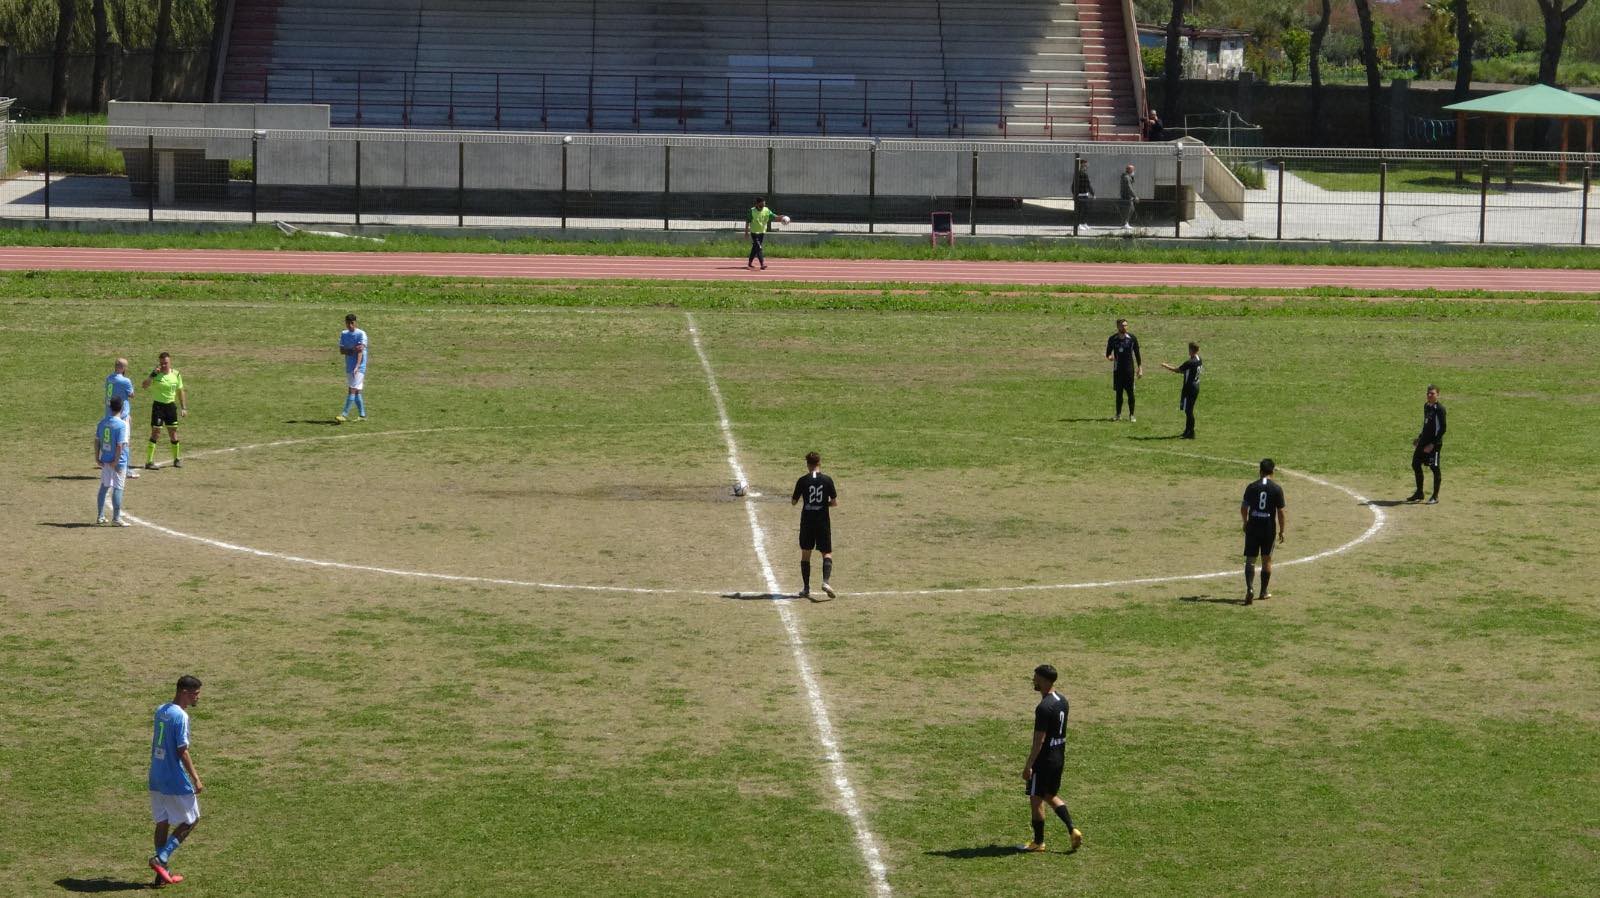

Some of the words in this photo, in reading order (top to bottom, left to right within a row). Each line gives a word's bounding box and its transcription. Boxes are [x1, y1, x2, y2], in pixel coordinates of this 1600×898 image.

[104, 427, 111, 443] 9
[809, 485, 823, 504] 25
[1259, 491, 1267, 510] 8
